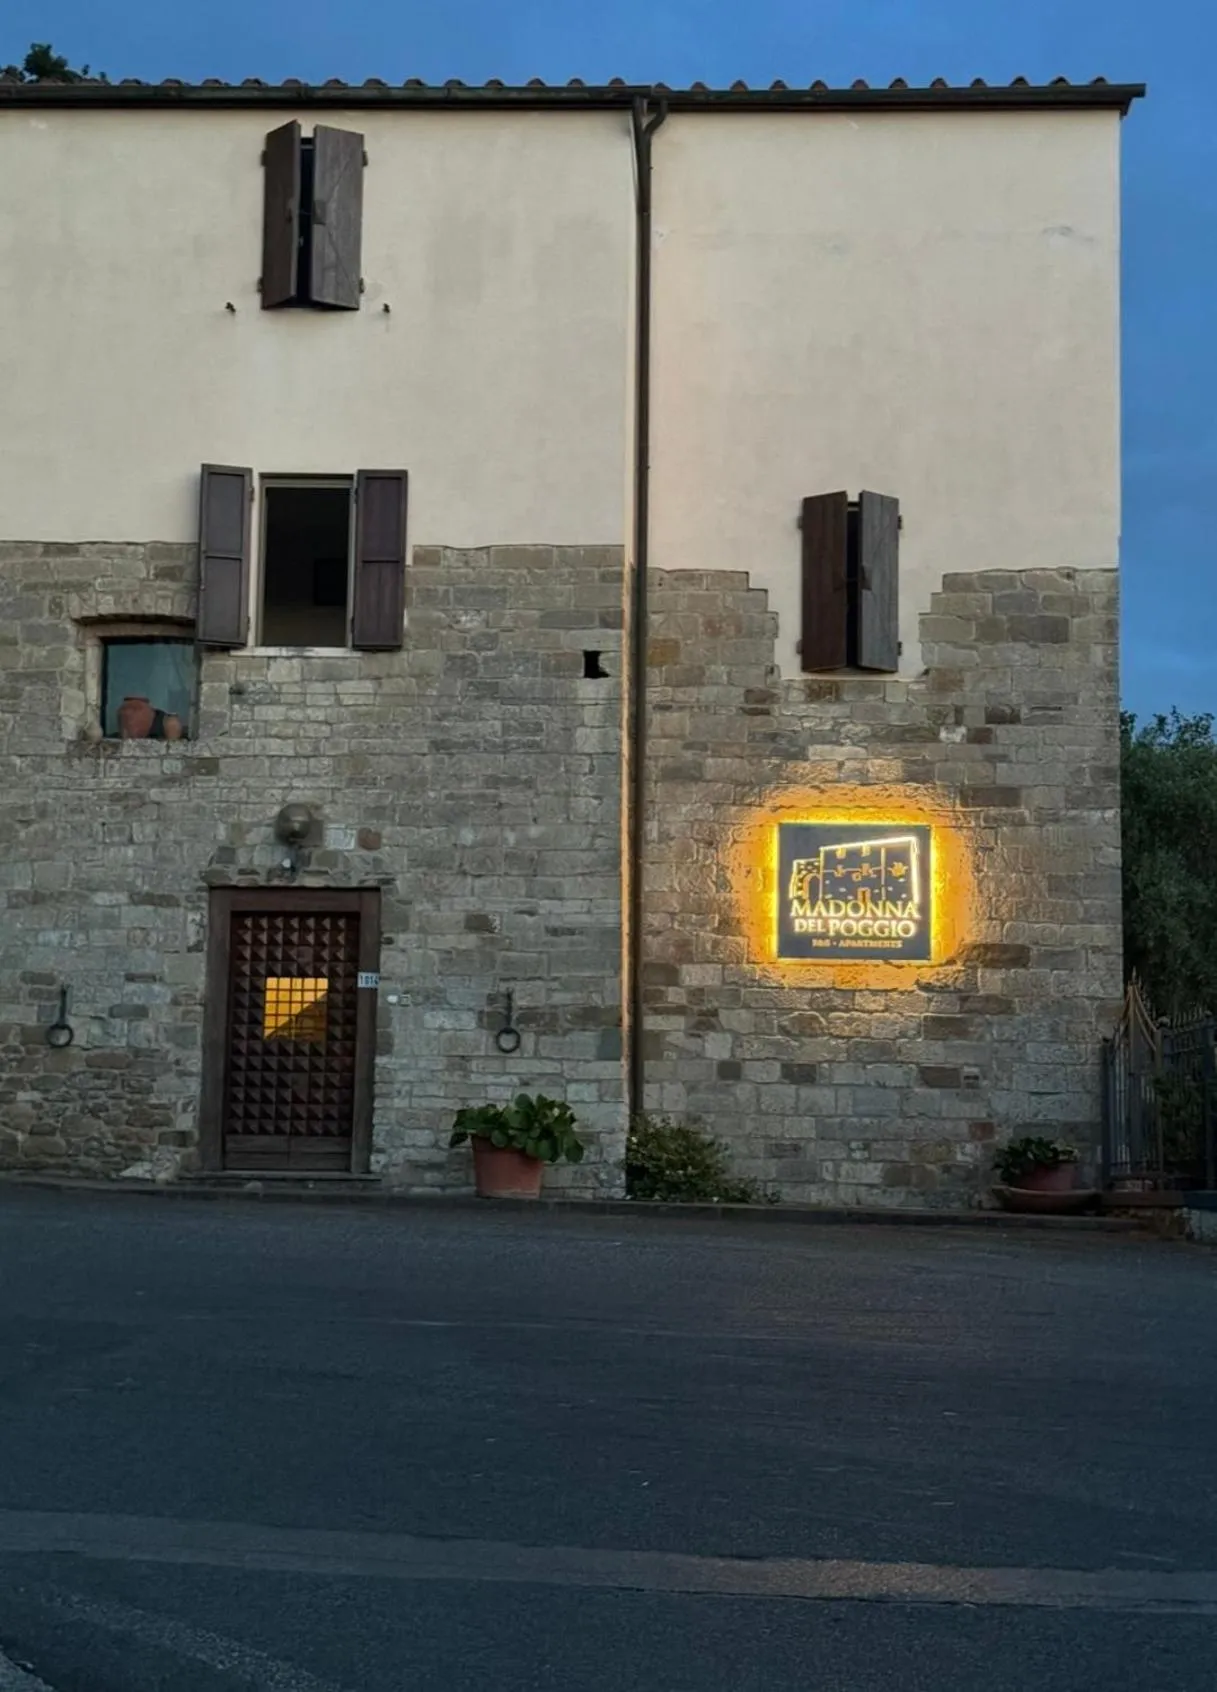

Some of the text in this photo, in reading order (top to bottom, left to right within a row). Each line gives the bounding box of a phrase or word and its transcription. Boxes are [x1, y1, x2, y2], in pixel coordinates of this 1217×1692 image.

[789, 899, 921, 918] MADONNA
[794, 918, 917, 938] DEL POGGIO
